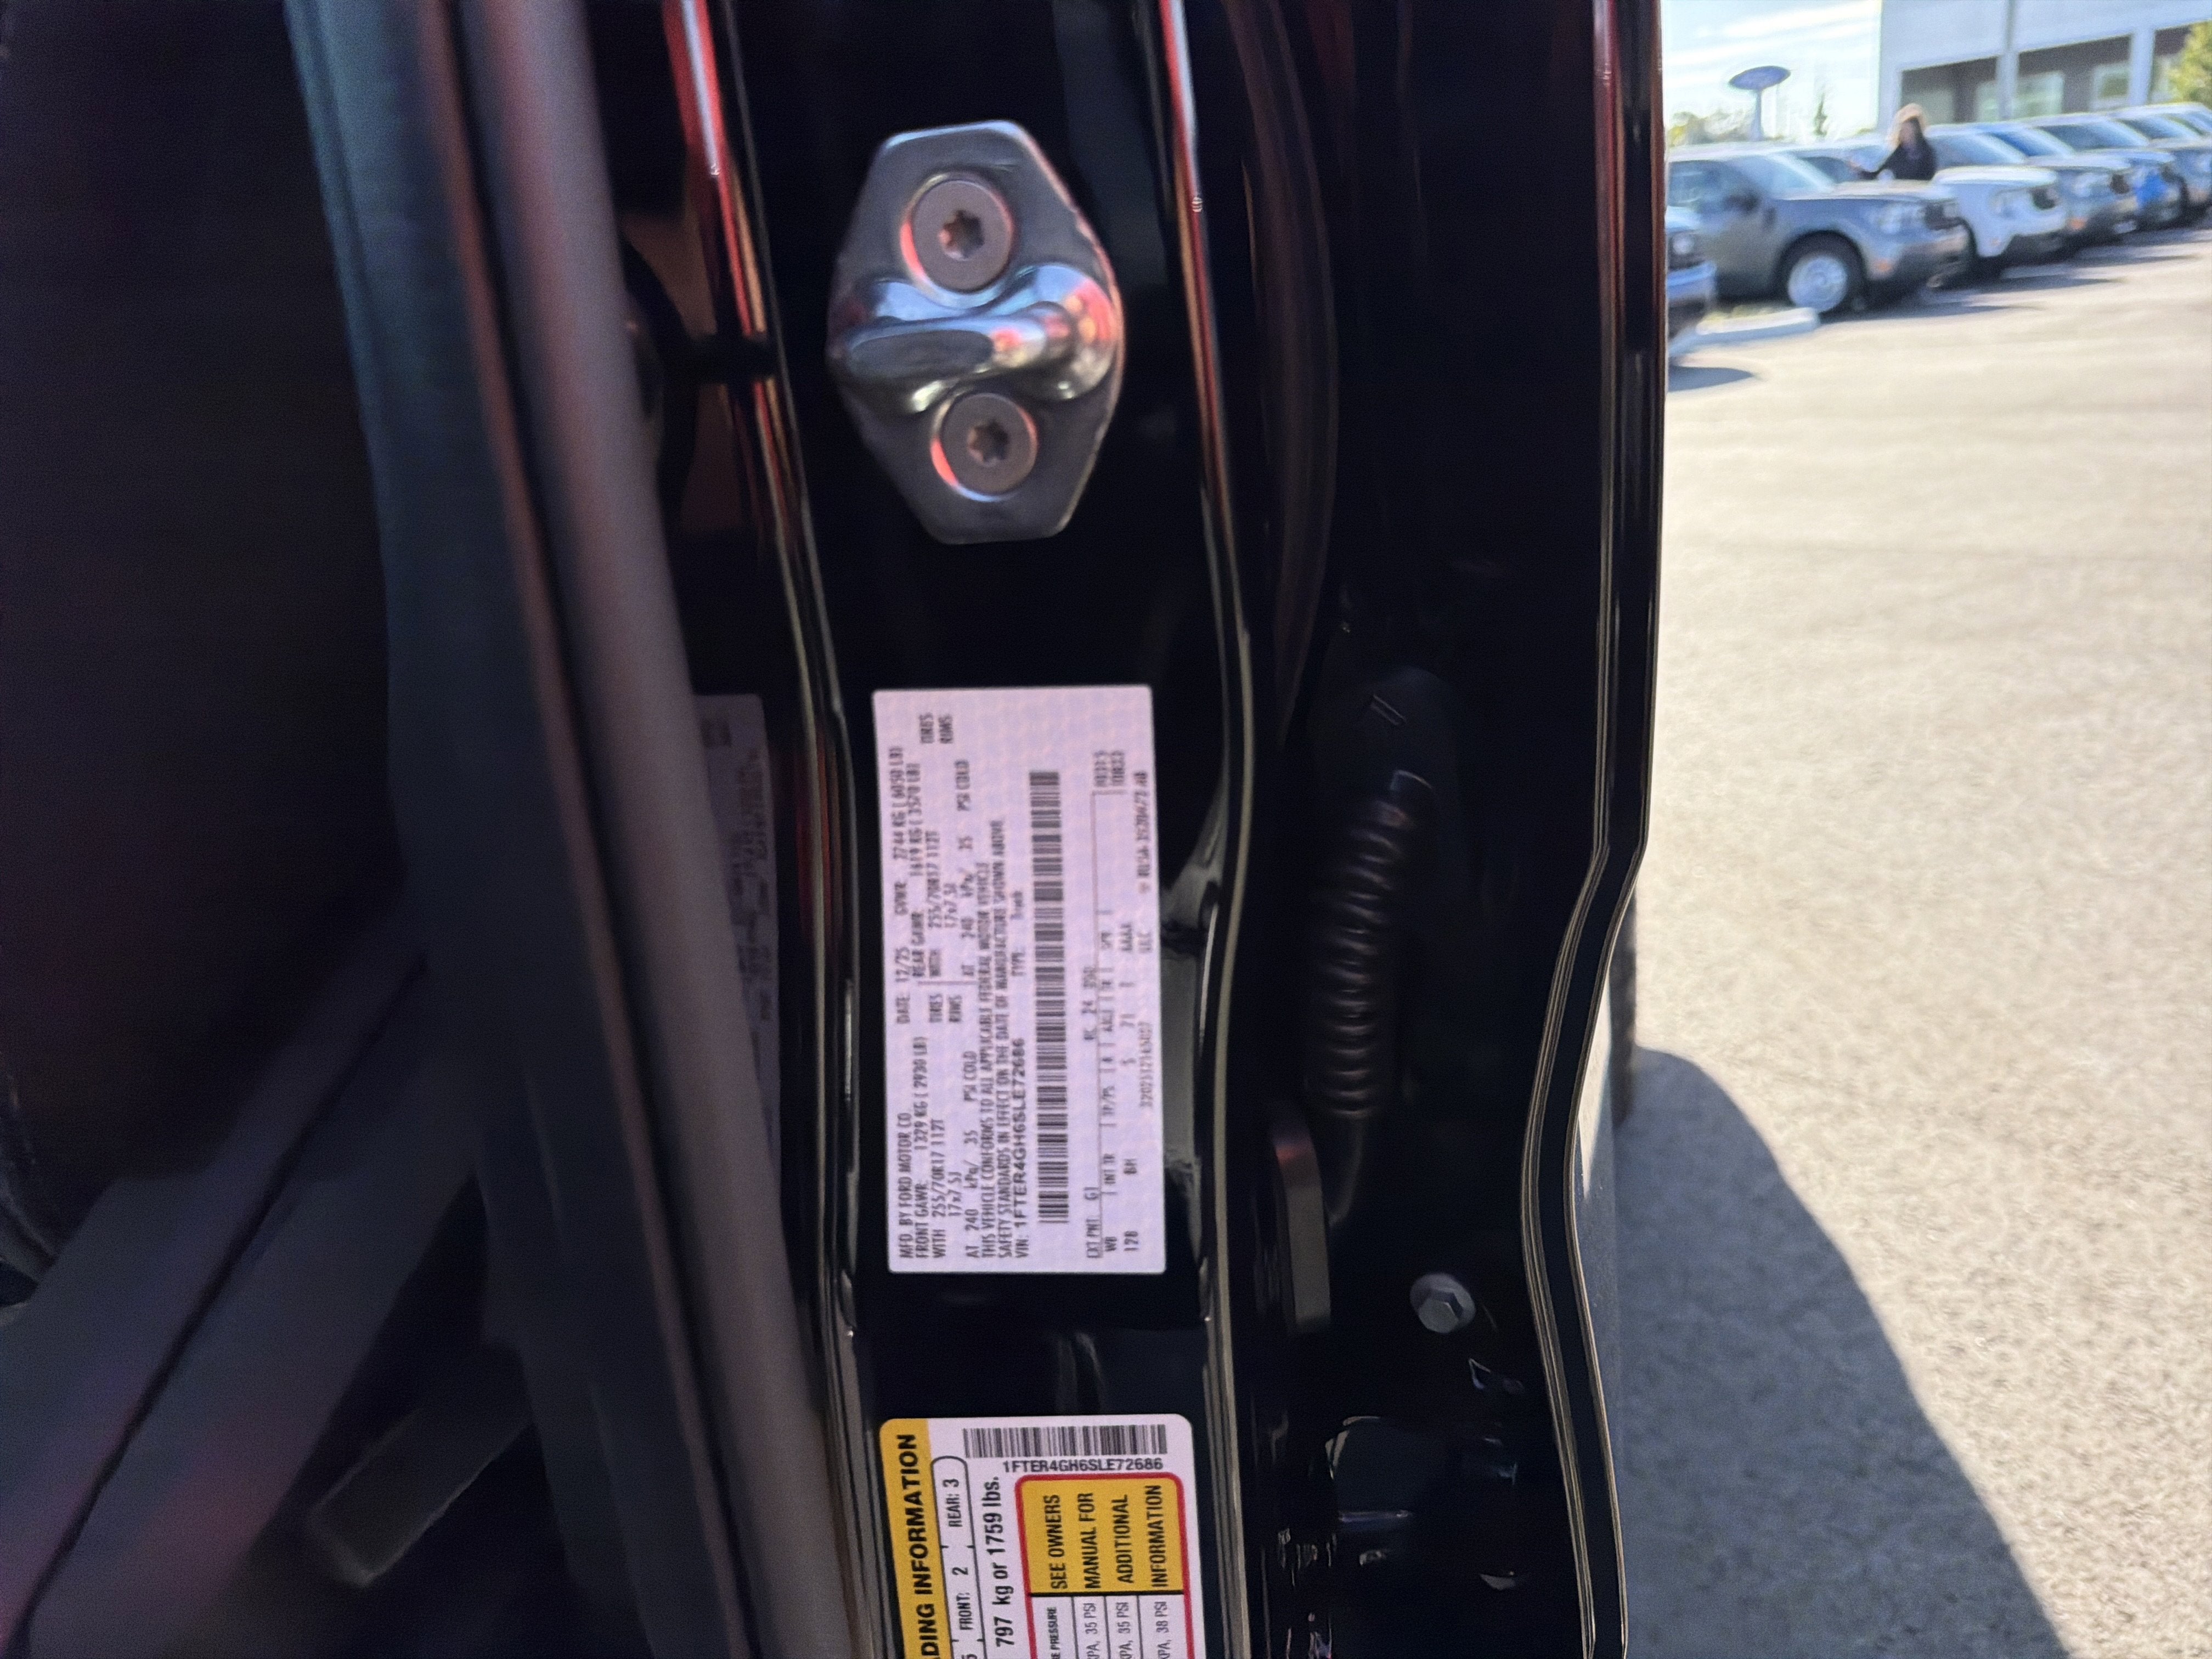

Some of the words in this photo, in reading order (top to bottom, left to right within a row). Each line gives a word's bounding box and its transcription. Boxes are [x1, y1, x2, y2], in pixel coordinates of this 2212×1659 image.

[911, 949, 926, 978] REAR
[928, 994, 943, 1023] TIRES
[947, 994, 962, 1023] RIMS
[995, 1013, 1009, 1041] DATE
[963, 1050, 978, 1081] COLD
[995, 1045, 1009, 1065] THE
[912, 1058, 928, 1088] 2930
[979, 1076, 994, 1094] ALL
[996, 1069, 1011, 1086] ON
[963, 1084, 978, 1102] PSI
[980, 1098, 994, 1113] TO
[913, 1101, 928, 1117] KG
[996, 1090, 1011, 1127] EFFECT
[913, 1120, 928, 1150] 1329
[963, 1130, 978, 1144] 35
[996, 1131, 1011, 1144] IN
[1012, 1039, 1028, 1228] 1FTER4GH6SLE72686
[896, 1131, 912, 1173] MOTOR
[980, 1117, 995, 1181] CONFORMS
[898, 1176, 912, 1207] FORD
[931, 1150, 947, 1218] 255/70R17
[996, 1147, 1012, 1215] STANDARDS
[898, 1212, 913, 1226] BY
[964, 1208, 980, 1231] 240
[980, 1184, 996, 1229] VEHICLE
[915, 1221, 929, 1259] FRONT
[931, 1229, 946, 1258] WITH
[965, 1245, 980, 1258] AT
[980, 1233, 996, 1258] THIS
[997, 1220, 1013, 1258] SAFETY
[1103, 1235, 1118, 1252] WB
[1123, 1230, 1139, 1252] 128
[1003, 1457, 1164, 1474] 1FTER4GH6SLE72686
[942, 1479, 960, 1488] 3
[981, 1476, 1002, 1507] lbs.
[896, 1434, 933, 1595] INFORMATION
[945, 1493, 963, 1528] REAR:
[1077, 1492, 1095, 1522] FOR
[983, 1513, 1007, 1555] 1759
[1043, 1494, 1065, 1558] OWNERS
[1111, 1494, 1135, 1584] ADDITIONAL
[1144, 1485, 1169, 1588] INFORMATION
[951, 1567, 968, 1576] 2
[991, 1563, 1008, 1579] or
[1082, 1527, 1101, 1589] MANUAL
[1048, 1562, 1068, 1590] SEE
[991, 1585, 1014, 1605] kg
[1153, 1601, 1168, 1617] PSI
[955, 1592, 974, 1630] FRONT:
[1082, 1602, 1097, 1618] PSI
[1115, 1602, 1129, 1618] PSI
[916, 1604, 940, 1659] DING
[993, 1616, 1015, 1647] 797
[1046, 1607, 1060, 1650] PRESSURE
[1084, 1622, 1098, 1634] 35
[1117, 1621, 1131, 1634] 35
[1155, 1620, 1169, 1633] 38
